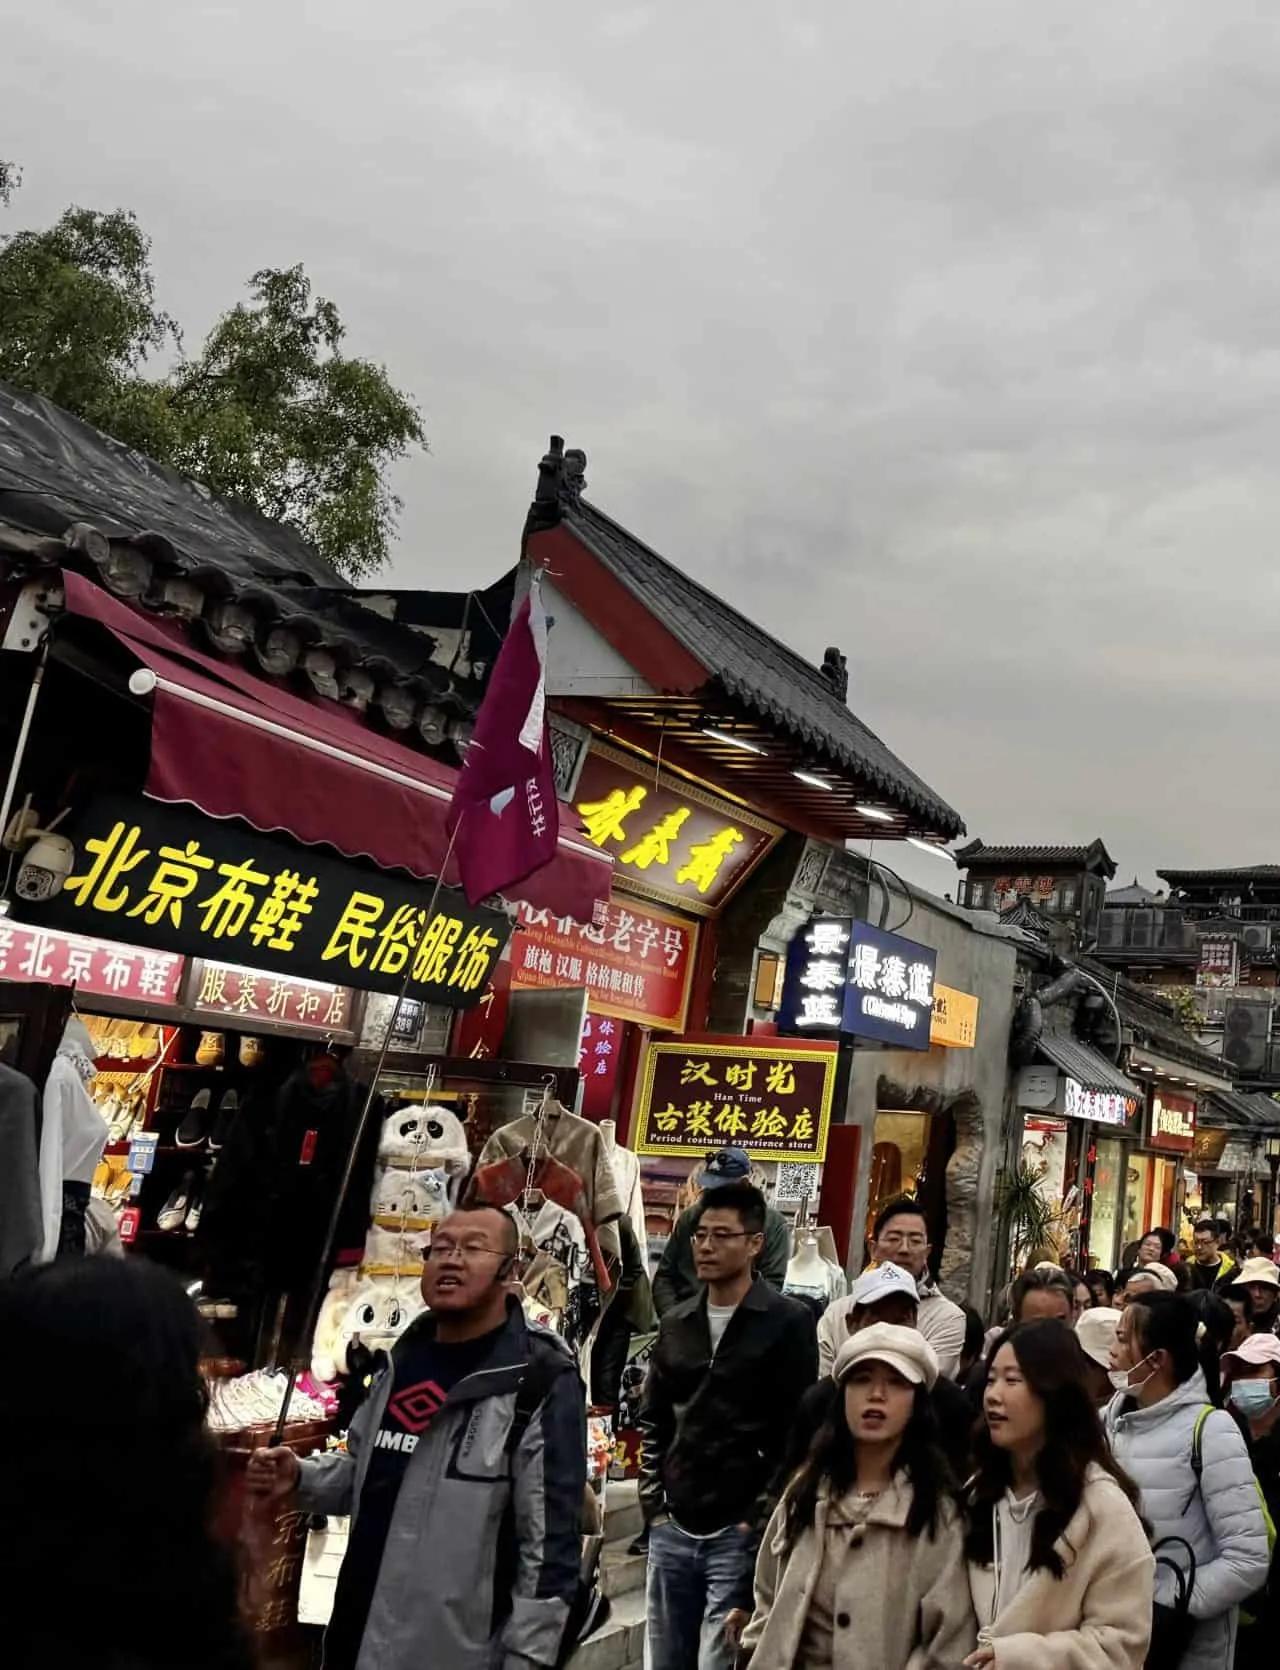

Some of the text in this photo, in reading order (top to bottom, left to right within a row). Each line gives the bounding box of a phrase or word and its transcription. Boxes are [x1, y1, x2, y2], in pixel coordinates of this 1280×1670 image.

[63, 820, 320, 951] 北京布鞋
[321, 890, 498, 993] 民俗服饰
[555, 952, 584, 983] 汉服
[795, 924, 850, 1027] 景泰蓝
[198, 965, 347, 1025] 服装折扣店
[593, 1020, 616, 1075] 体验店
[680, 1059, 797, 1095] 汉时光
[714, 1092, 763, 1104] Han Time
[650, 1132, 814, 1150] Period costume experience store
[652, 1100, 816, 1141] 古装体验店
